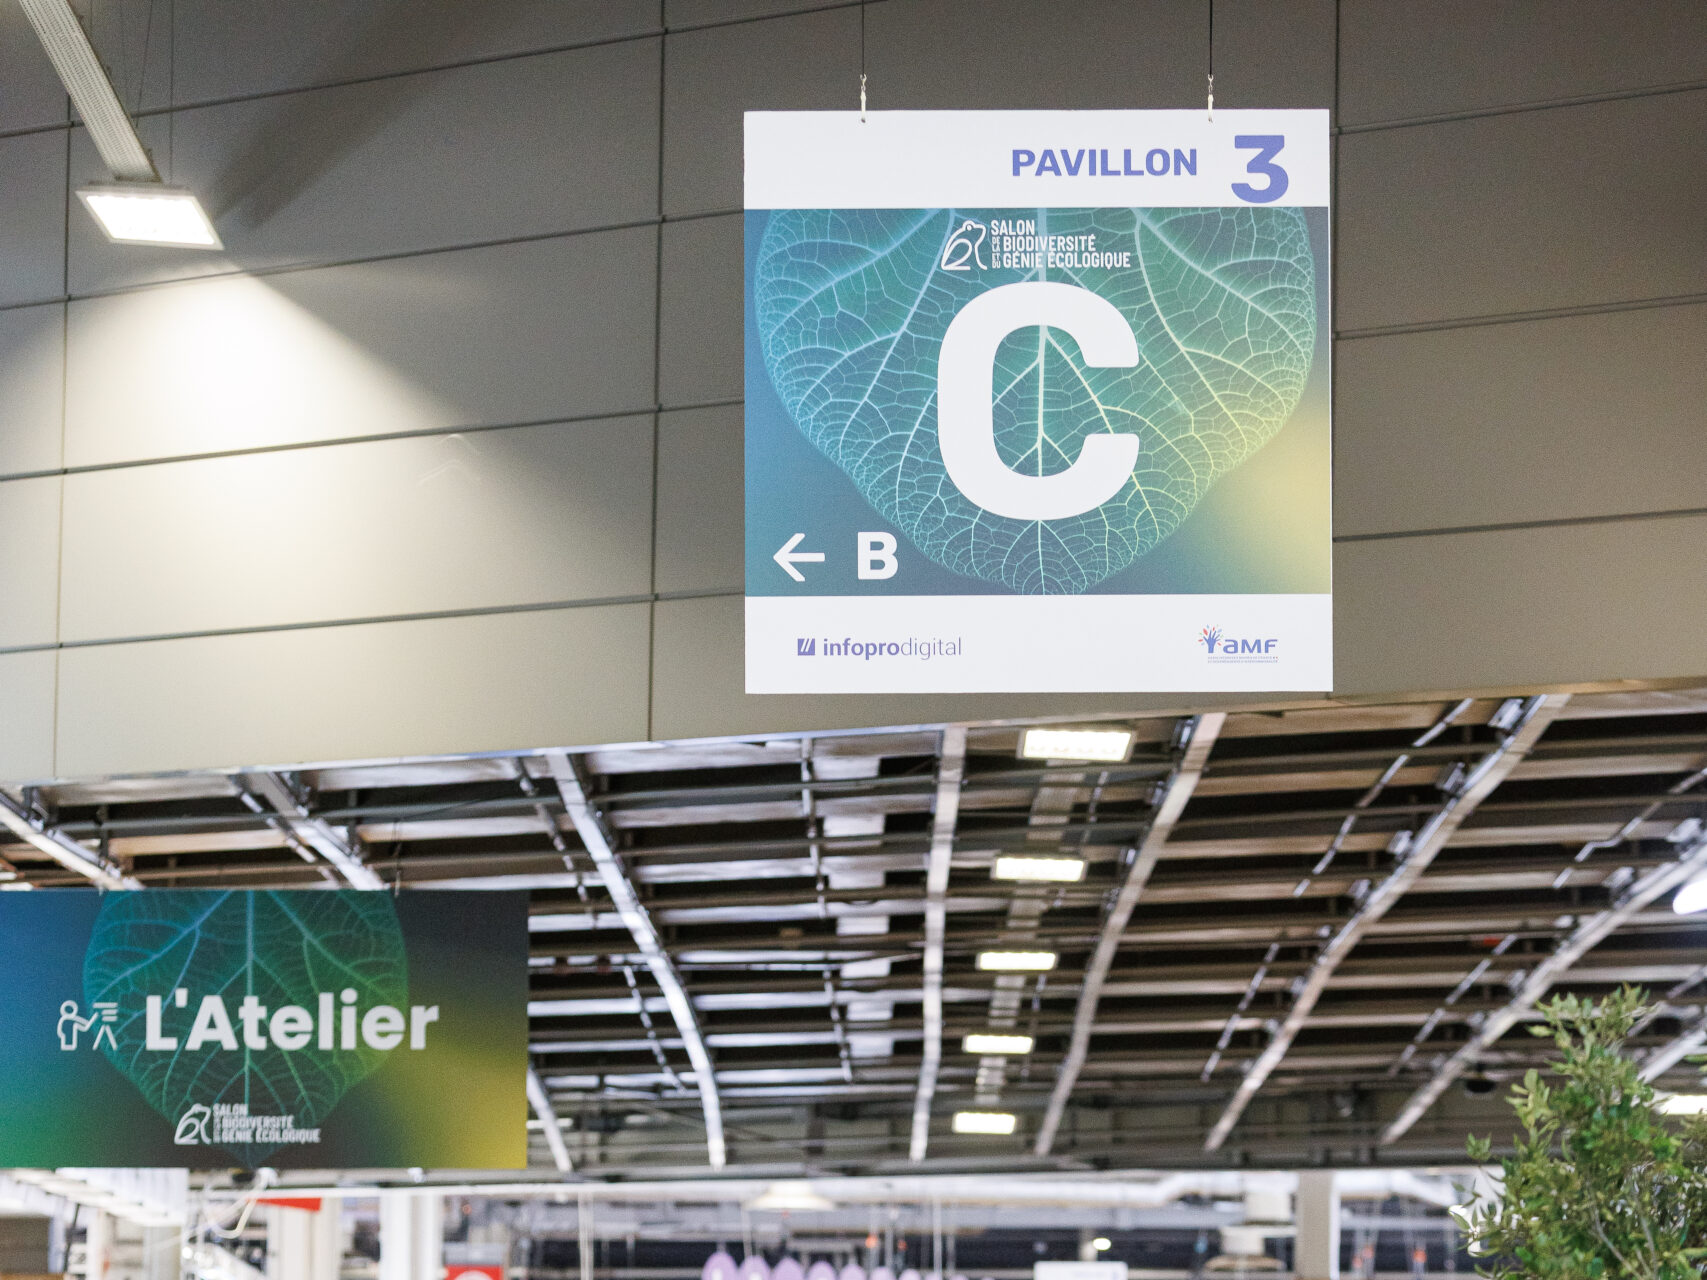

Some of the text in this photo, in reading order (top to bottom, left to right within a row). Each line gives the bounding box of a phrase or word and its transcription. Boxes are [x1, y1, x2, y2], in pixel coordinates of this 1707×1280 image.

[1012, 134, 1289, 204] PAVILLON 3
[991, 219, 1035, 236] SALON
[1003, 233, 1096, 251] BIODIVERSITÉ
[1003, 250, 1131, 270] GÉNIE ÉCOLOGIQUE
[937, 281, 1140, 521] C
[857, 531, 899, 580] B
[823, 636, 962, 661] infoprodigital
[145, 987, 440, 1050] L'Atelier
